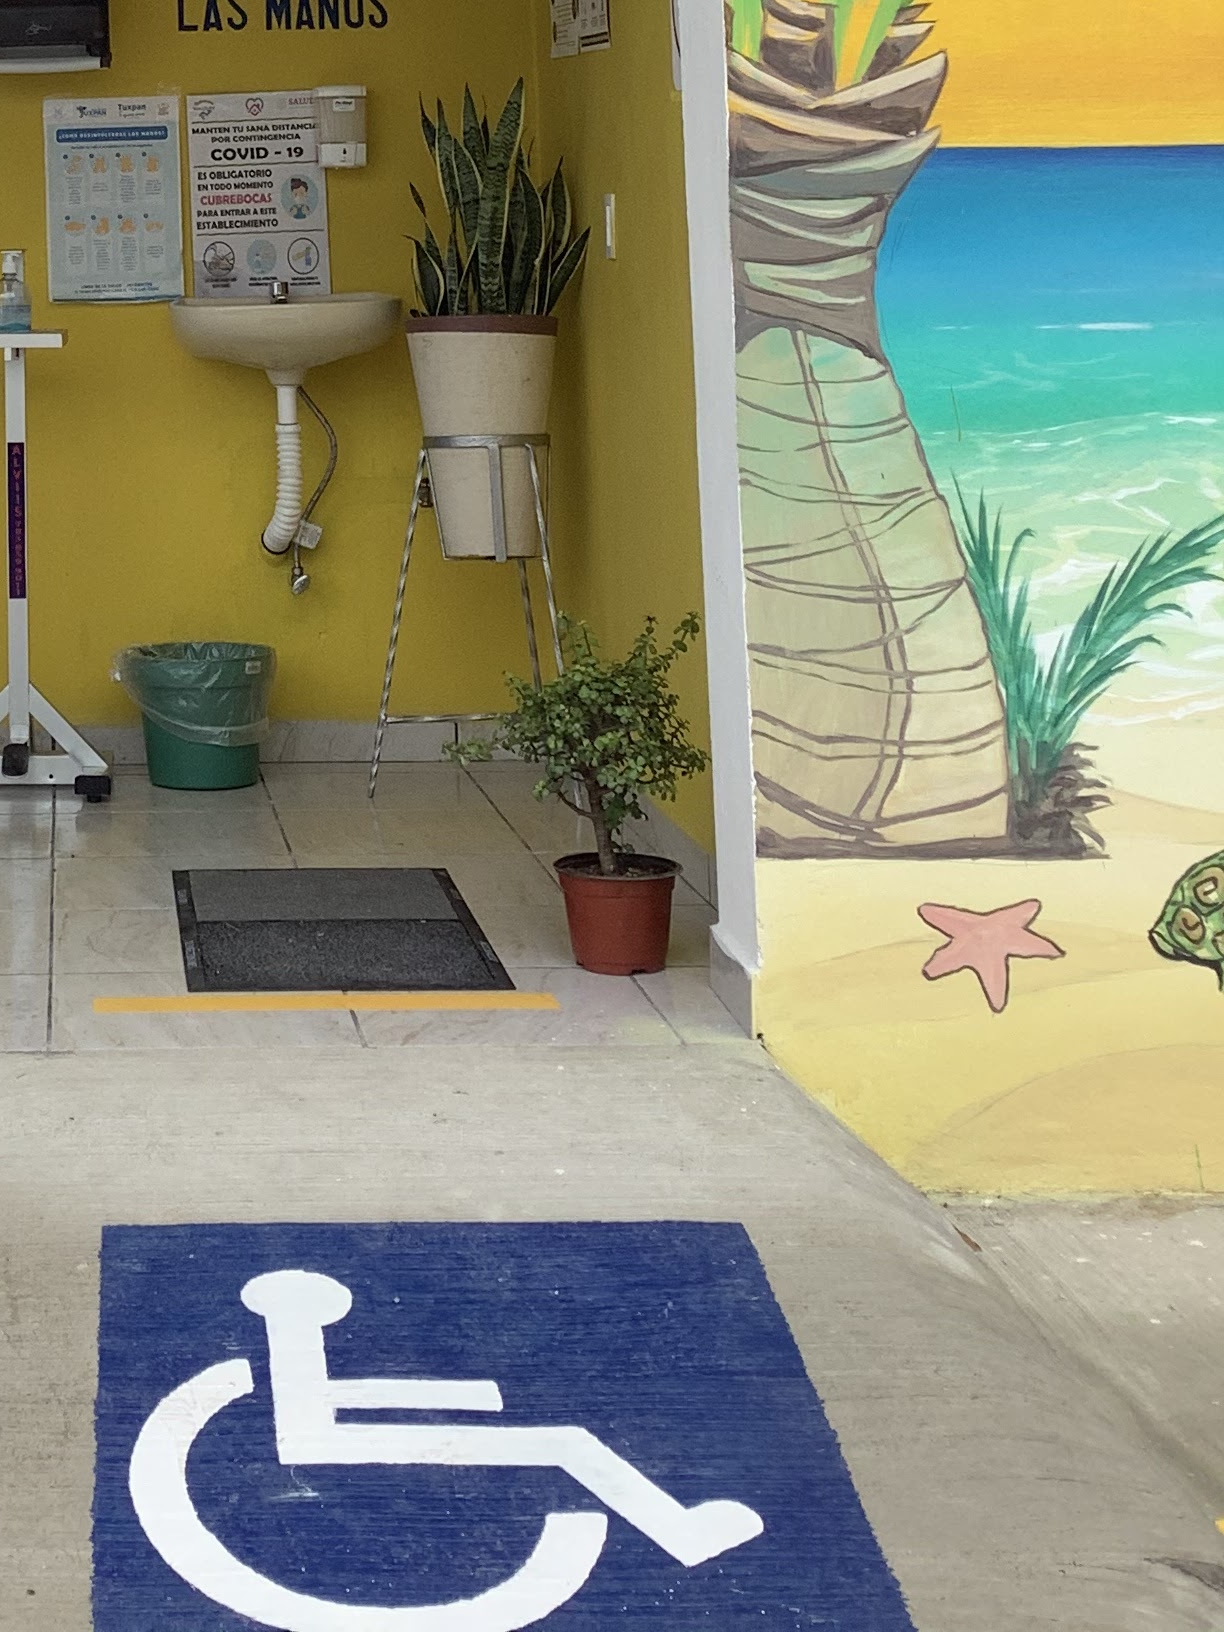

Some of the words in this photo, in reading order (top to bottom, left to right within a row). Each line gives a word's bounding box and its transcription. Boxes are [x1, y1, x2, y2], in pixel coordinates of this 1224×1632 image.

[232, 125, 244, 133] TU
[246, 124, 270, 133] SANA
[211, 135, 231, 143] POR
[233, 133, 301, 142] CONTINGENCIA
[210, 147, 269, 161] COVID
[287, 146, 304, 157] 19
[197, 172, 207, 180] ES
[209, 169, 272, 179] OBLIGATORIO
[197, 183, 209, 191] EN
[210, 182, 232, 190] TODO
[233, 181, 274, 189] MOMENTO
[200, 193, 273, 205] CUBREBOCAS
[220, 208, 251, 216] ENTRAR
[260, 207, 277, 215] ESTE
[196, 218, 279, 230] ESTABLECIMIENTO
